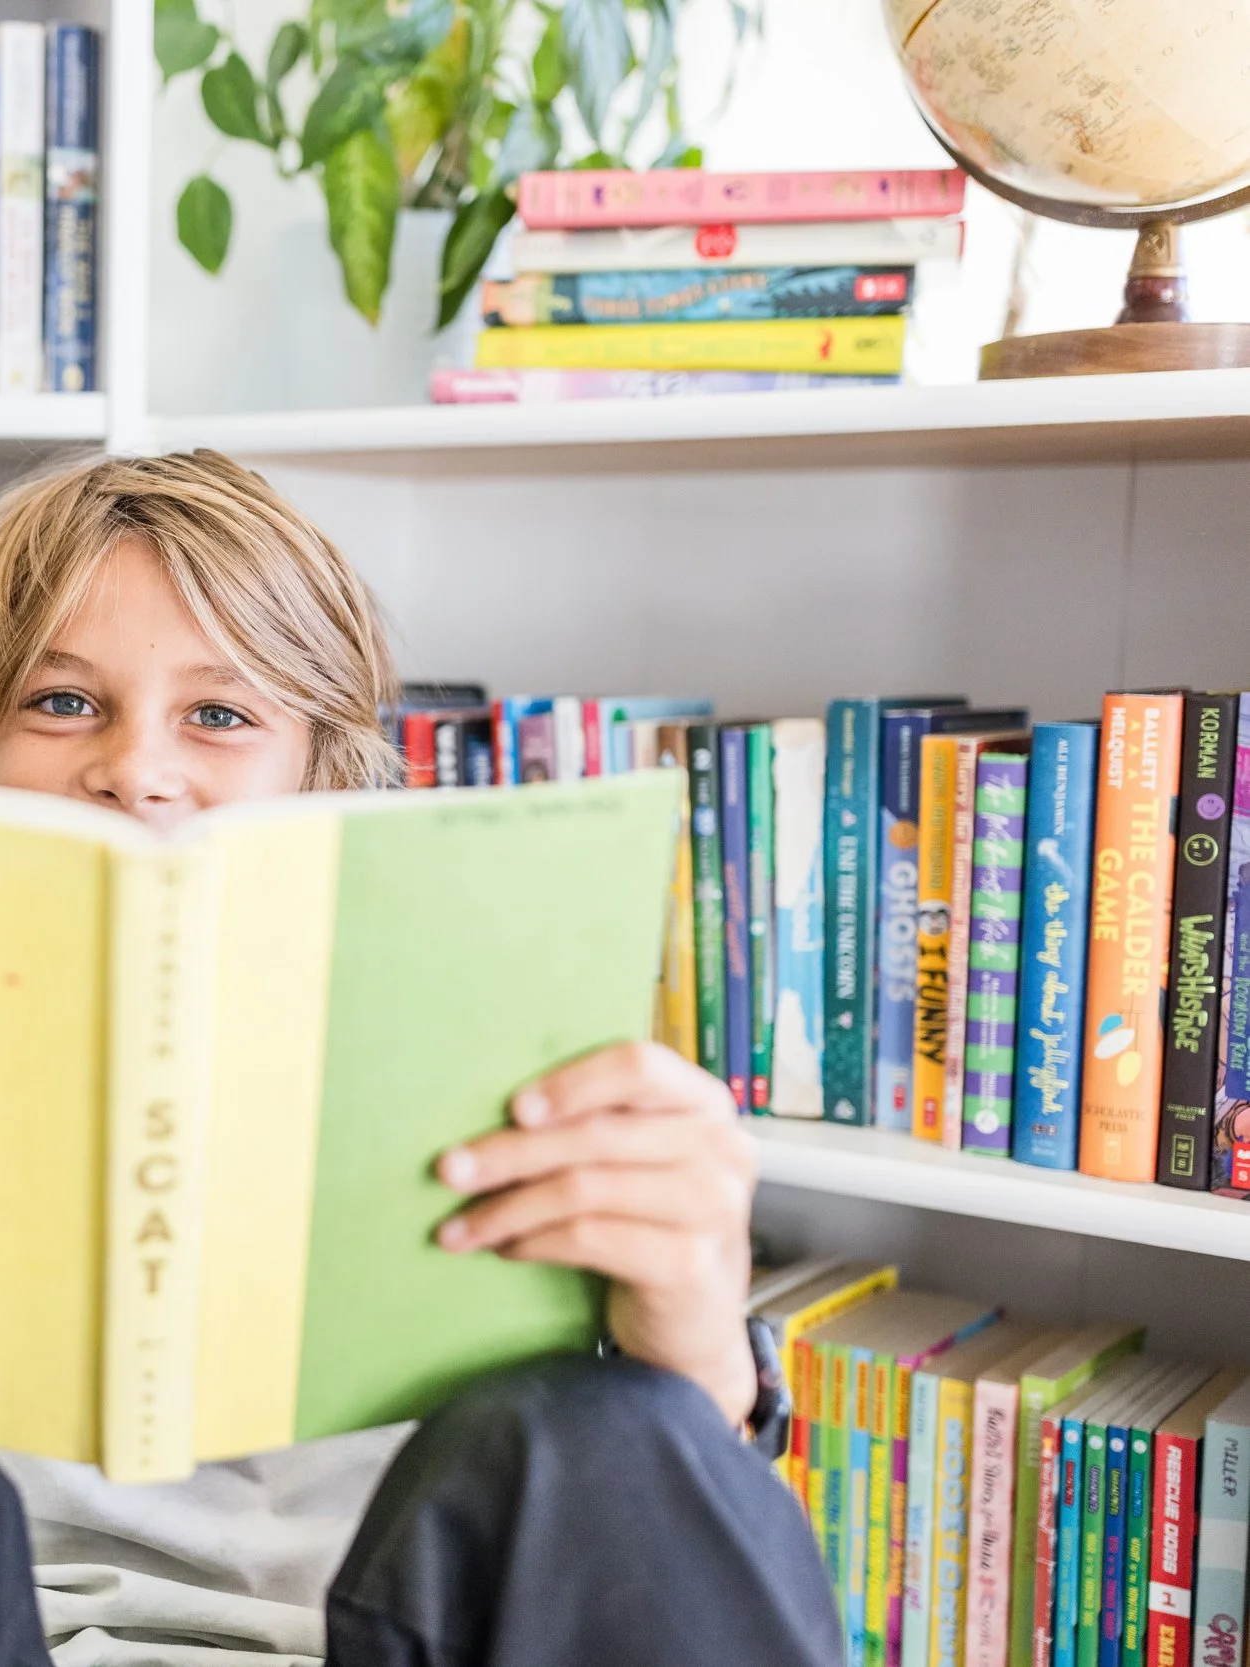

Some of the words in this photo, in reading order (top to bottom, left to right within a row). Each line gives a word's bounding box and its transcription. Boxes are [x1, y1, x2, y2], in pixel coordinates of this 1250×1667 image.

[1056, 738, 1069, 762] ALI
[1106, 706, 1127, 788] HELQUIST
[1140, 707, 1160, 790] BALLIETT
[1196, 707, 1221, 779] KORMAN
[982, 773, 1016, 807] The
[1053, 763, 1068, 836] BENJAMIN
[1130, 797, 1160, 862] THE
[1043, 882, 1071, 917] the
[1094, 847, 1124, 941] GAME
[836, 912, 857, 1000] UNICORN
[885, 860, 918, 1003] GHOSTS
[920, 944, 947, 959] I
[1035, 918, 1068, 968] thing
[1122, 869, 1156, 997] CALDER
[1239, 933, 1250, 952] and
[1239, 956, 1249, 972] the
[918, 969, 949, 1066] FUNNY
[1040, 970, 1070, 1028] about
[1230, 976, 1250, 1037] DOOMSDAY
[1027, 1027, 1071, 1115] jellyfish
[1230, 1041, 1246, 1070] RACE
[134, 1098, 180, 1296] SCAT
[1163, 1444, 1183, 1522] RESCUE
[1222, 1437, 1239, 1498] MILLER
[1162, 1523, 1180, 1575] DOGS
[1157, 1624, 1176, 1667] EMB
[1202, 1613, 1240, 1667] CAM
